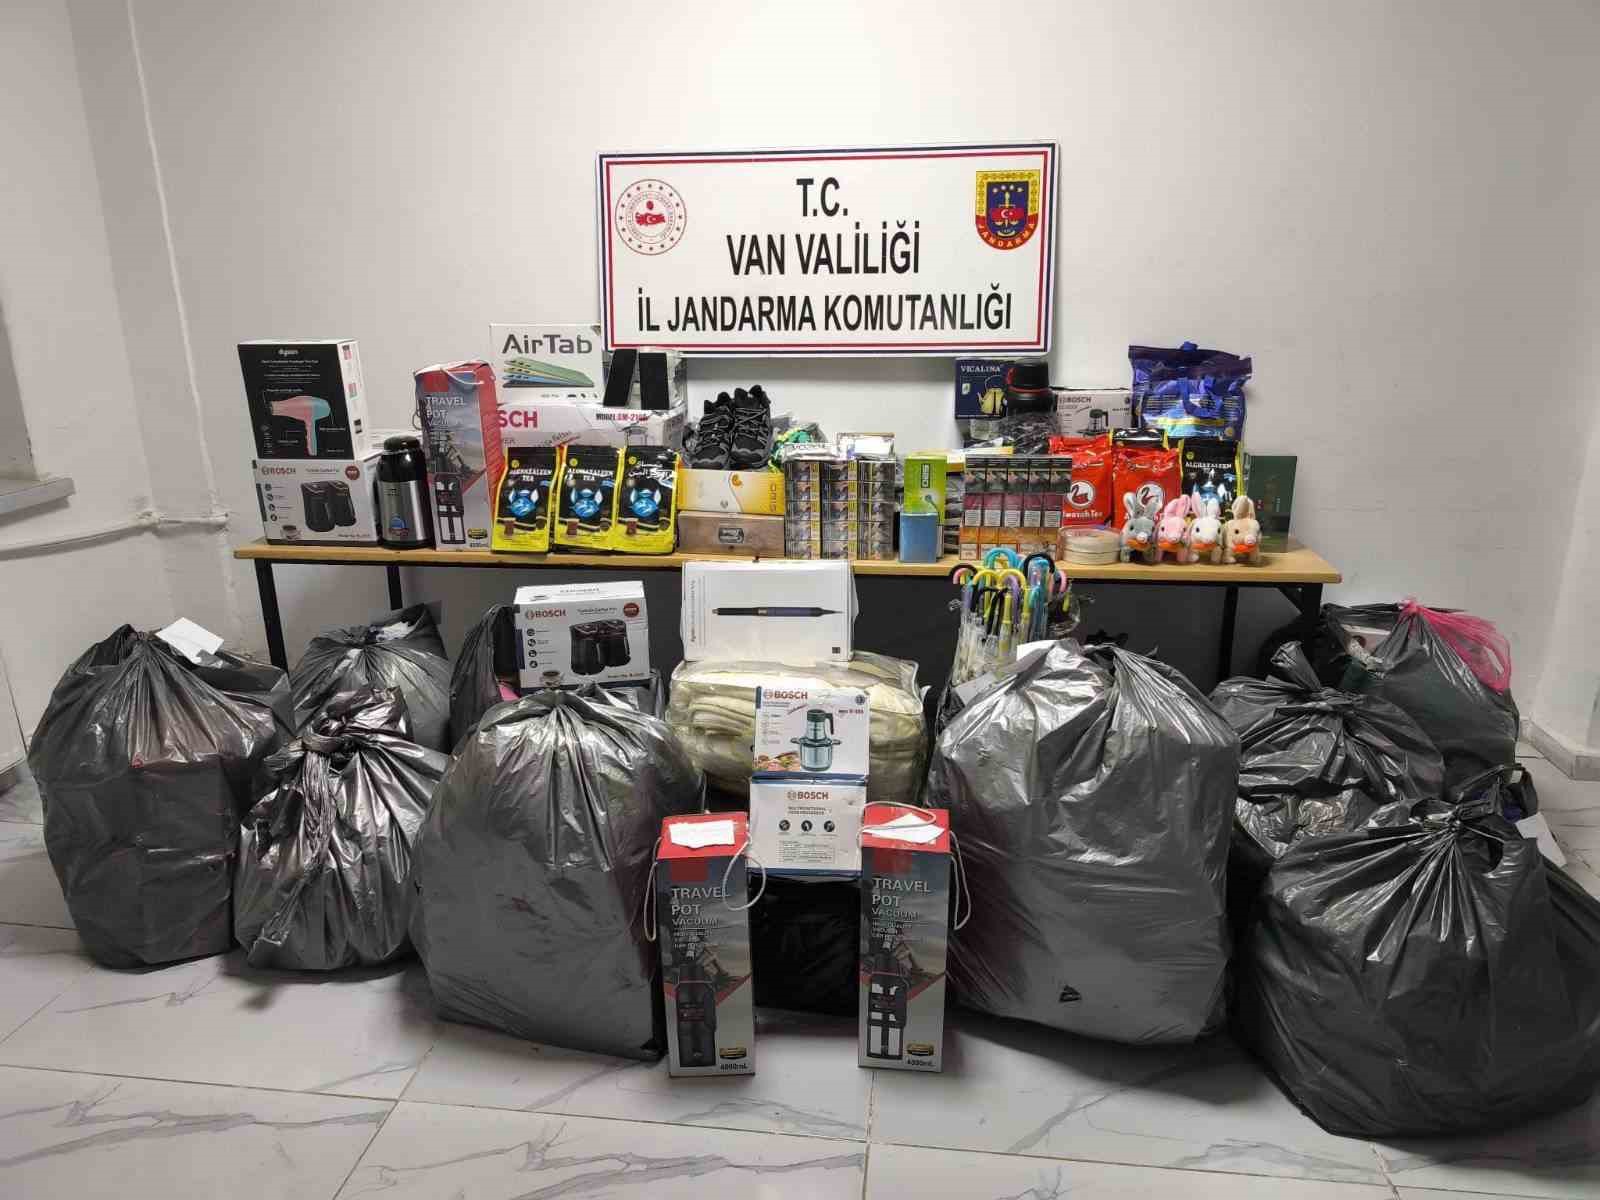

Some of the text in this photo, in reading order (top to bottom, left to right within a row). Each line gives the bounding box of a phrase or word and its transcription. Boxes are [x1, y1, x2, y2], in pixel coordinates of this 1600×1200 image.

[796, 177, 848, 217] T.C.
[727, 220, 920, 275] VAN VALİLİĞİ
[638, 282, 1012, 332] İL JANDARMA KOMUTANLIĞI
[501, 334, 593, 354] AirTab
[424, 396, 466, 406] TRAVEL
[1069, 396, 1092, 404] BOSCH
[497, 410, 538, 428] SCH
[270, 467, 296, 475] BOSCH
[535, 609, 567, 618] BOSCH
[774, 691, 808, 700] BOSCH
[797, 791, 829, 800] BOSCH
[871, 877, 931, 893] TRAVEL
[671, 887, 729, 898] TRAVEL
[871, 894, 900, 907] POT
[671, 903, 700, 915] POT
